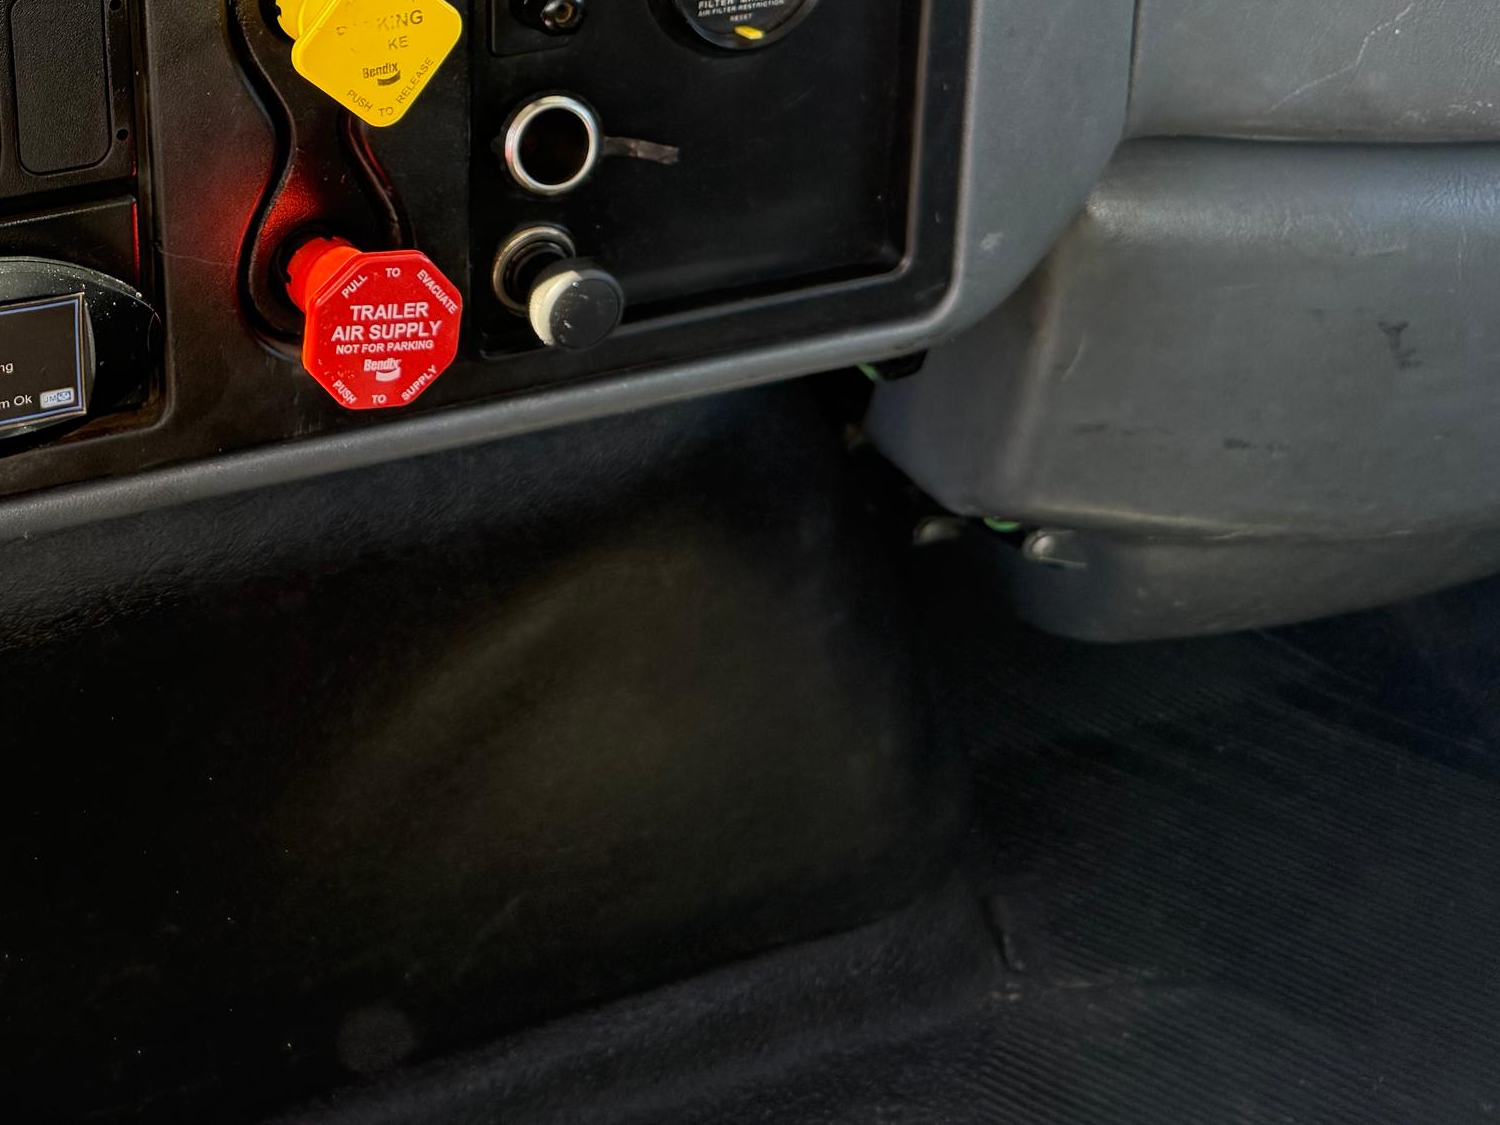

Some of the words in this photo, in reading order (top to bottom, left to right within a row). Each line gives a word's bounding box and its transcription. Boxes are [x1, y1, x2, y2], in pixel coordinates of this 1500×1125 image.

[698, 7, 711, 17] AIR
[362, 61, 399, 79] Bendix
[346, 88, 373, 112] PUSH
[378, 106, 394, 118] TO
[395, 57, 435, 104] RELEASE
[341, 274, 368, 299] PULL
[385, 267, 401, 278] TO
[416, 269, 459, 315] EVACUATE
[350, 302, 429, 321] TRAILER
[331, 325, 364, 342] AIR
[369, 320, 443, 340] SUPPLY
[336, 343, 359, 355] NOT
[361, 342, 385, 354] FOR
[387, 339, 434, 352] PARKING
[363, 357, 402, 372] Bendix
[332, 379, 357, 404] PUSH
[371, 394, 387, 404] TO
[401, 364, 438, 401] SUPPLY
[13, 394, 33, 408] Ok
